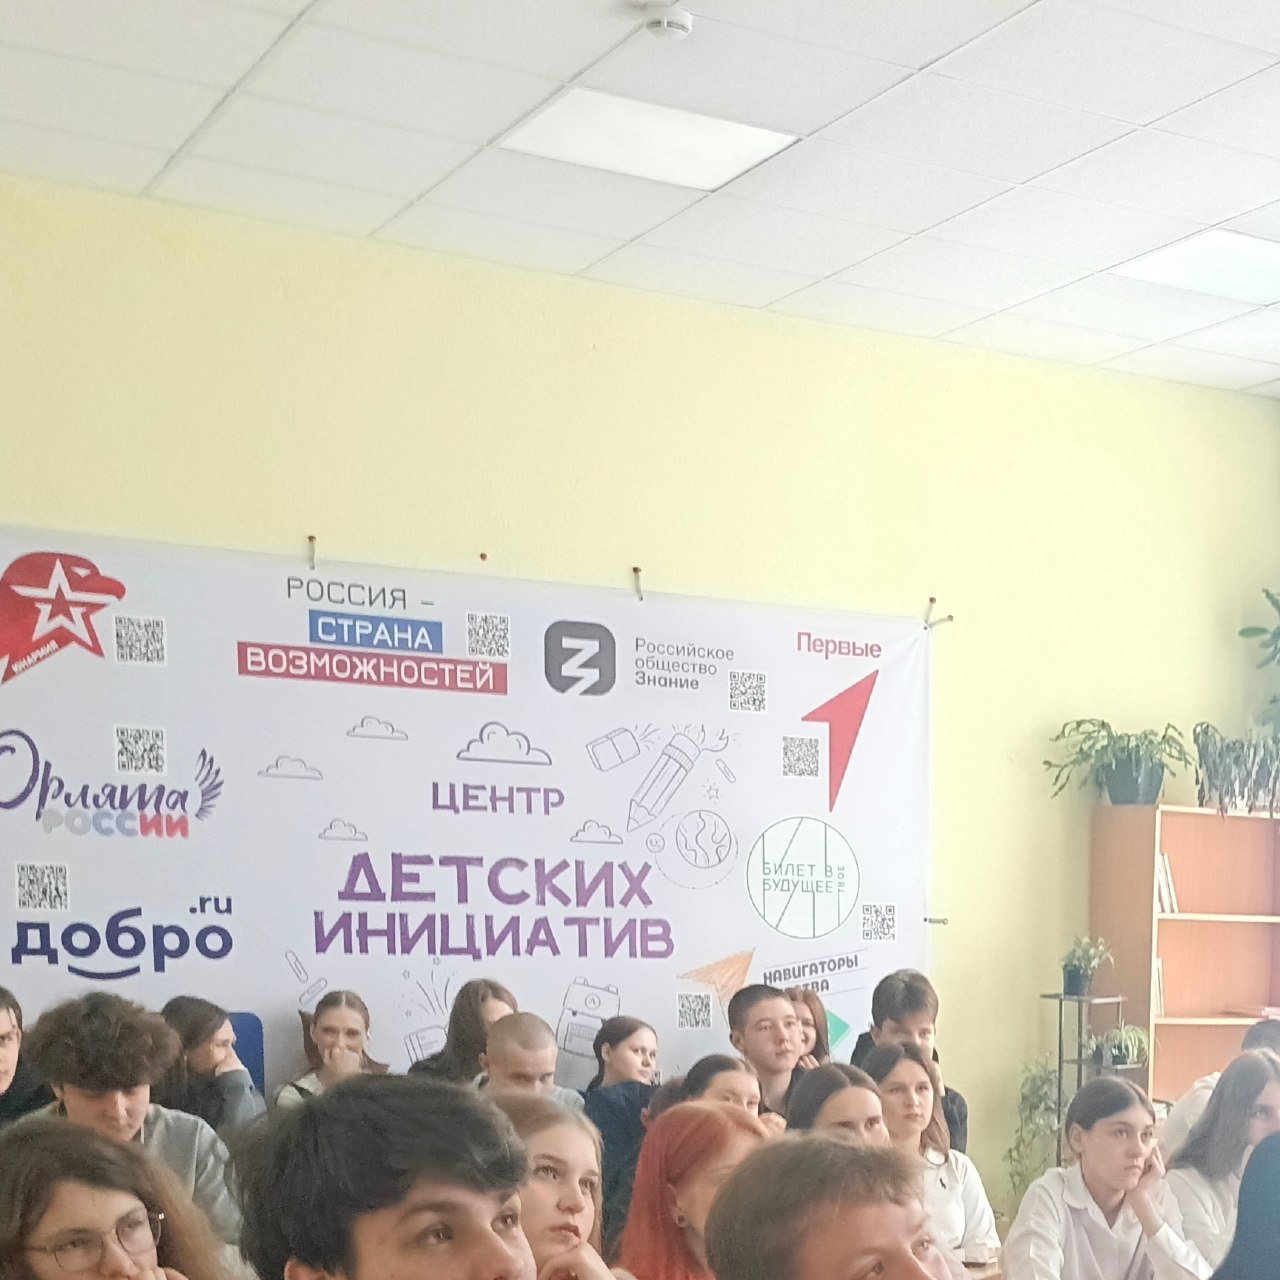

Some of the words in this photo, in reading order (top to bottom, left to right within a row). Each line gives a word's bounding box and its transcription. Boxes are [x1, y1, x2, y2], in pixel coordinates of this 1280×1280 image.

[287, 576, 407, 609] РОССИЯ
[317, 616, 433, 650] СТРАНА
[796, 632, 882, 660] Первые
[635, 637, 734, 661] Российское
[246, 647, 494, 689] ВОЗМОЖНОСТЕЙ
[634, 655, 717, 675] общество
[634, 671, 699, 690] Знание
[432, 782, 565, 815] ЦЕНТР
[42, 808, 190, 839] РОССИИ
[337, 852, 653, 908] ДЕТСКИХ
[762, 862, 816, 877] БИЛЕТ
[762, 878, 833, 893] БУДУЩЕЕ
[189, 895, 233, 914] .ru
[11, 907, 233, 973] добро
[313, 910, 675, 961] ИНИЦИАТИВ
[763, 954, 859, 986] НАВИГАТОРЫ
